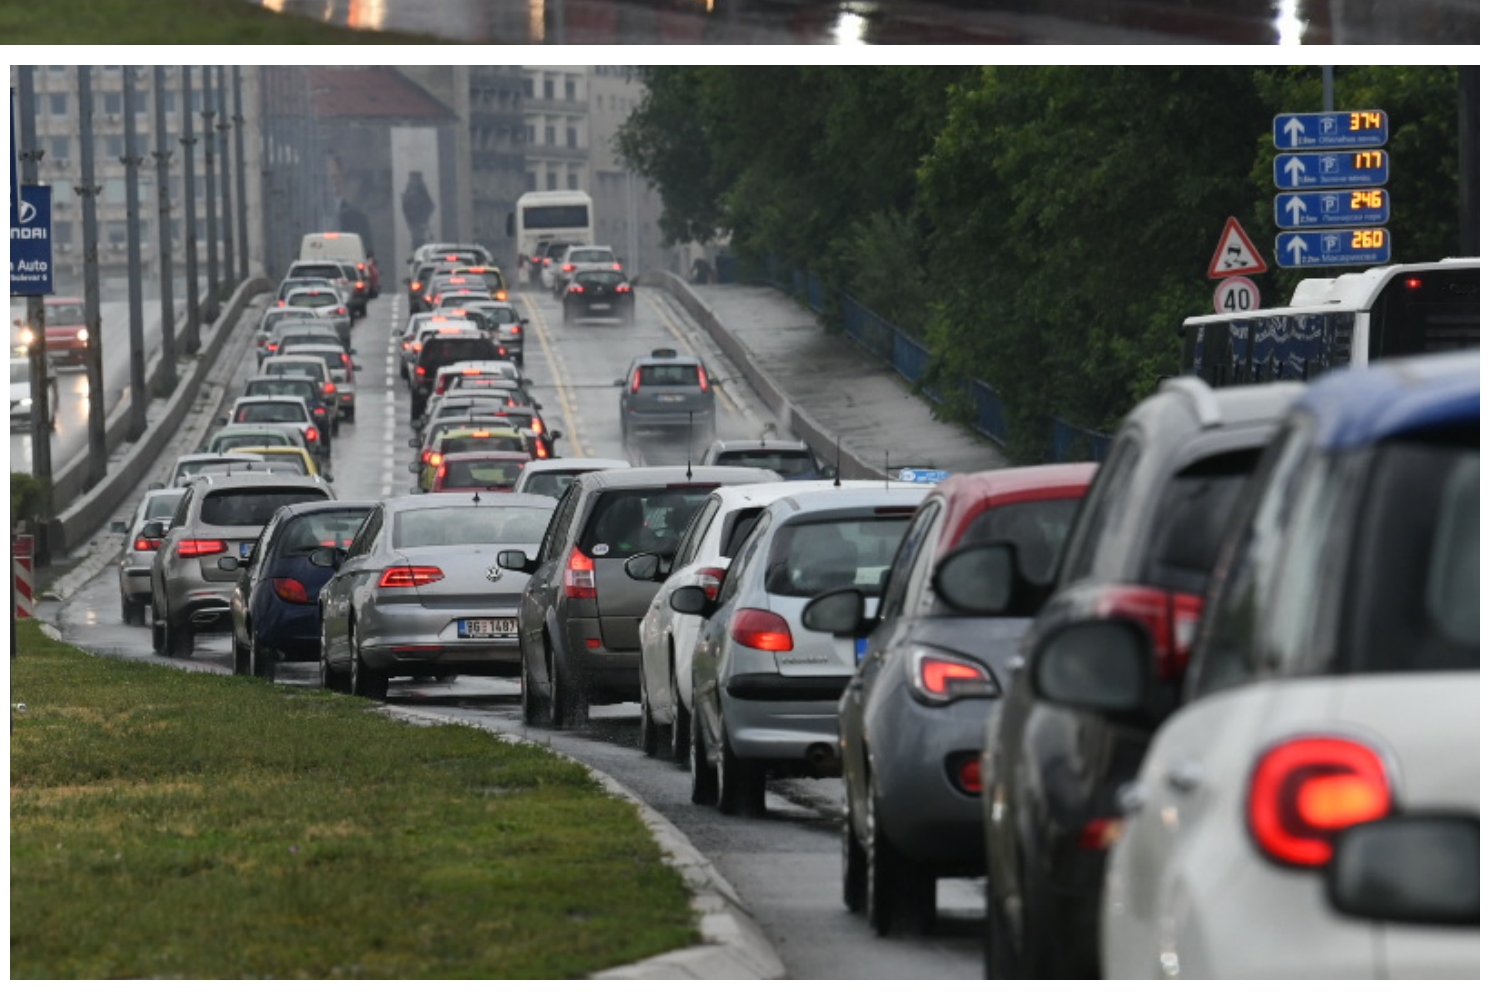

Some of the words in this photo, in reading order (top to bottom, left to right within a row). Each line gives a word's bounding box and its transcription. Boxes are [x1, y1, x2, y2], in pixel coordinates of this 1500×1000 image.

[1349, 112, 1381, 130] 374
[1356, 151, 1382, 169] 177
[1350, 191, 1382, 209] 246
[1351, 230, 1384, 249] 260
[17, 259, 48, 272] Auto
[1224, 287, 1250, 312] 40
